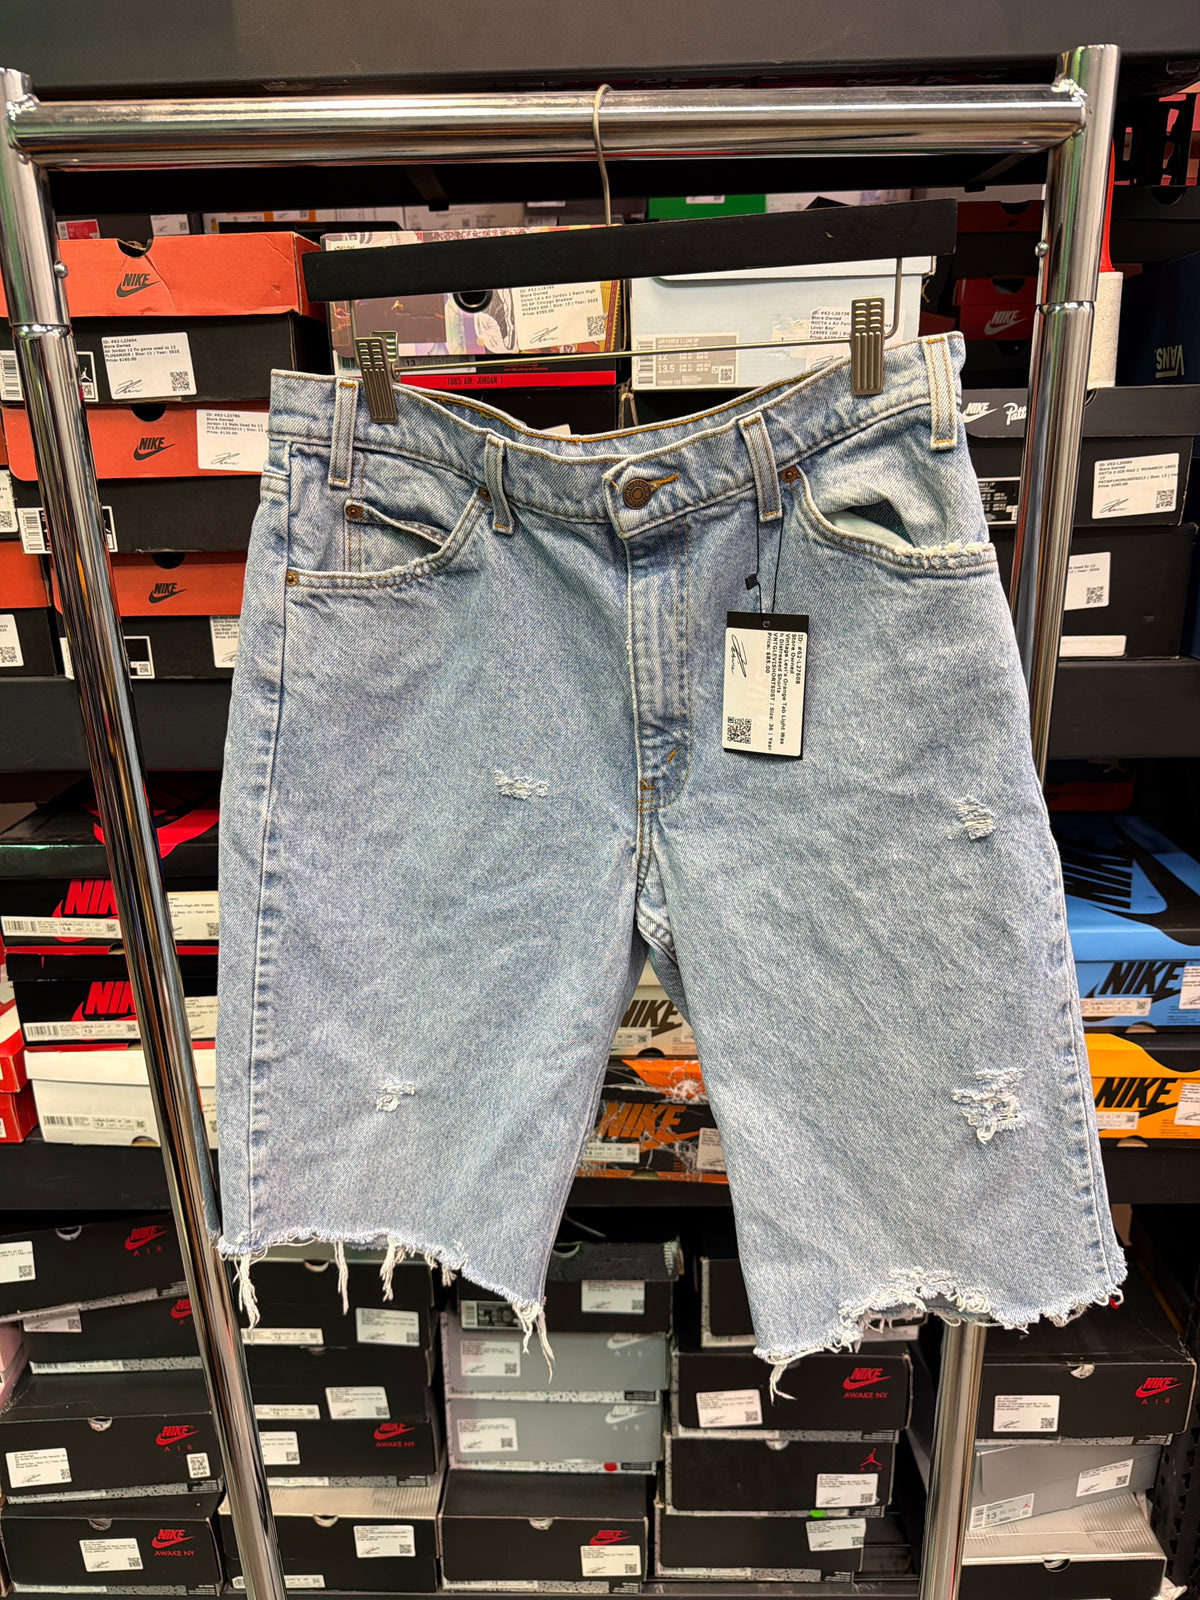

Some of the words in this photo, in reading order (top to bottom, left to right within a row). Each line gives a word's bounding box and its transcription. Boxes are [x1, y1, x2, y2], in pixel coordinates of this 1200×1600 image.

[122, 273, 150, 287] NIKE
[991, 310, 1020, 324] NIKE
[1155, 344, 1184, 378] VANS
[658, 364, 674, 373] 13.5
[476, 376, 497, 385] JORDAN
[966, 402, 990, 414] NIKE
[139, 437, 165, 450] NIKE
[154, 582, 177, 594] NIKE
[1098, 962, 1187, 994] NIKE
[1094, 1078, 1179, 1108] NIKE
[600, 1102, 686, 1138] NIKE
[130, 1226, 162, 1240] NIKE
[851, 1368, 883, 1380] NIKE
[1143, 1378, 1174, 1389] NIKE
[611, 1405, 640, 1415] NIKE
[162, 1425, 189, 1437] NIKE
[164, 1444, 192, 1452] AIR
[987, 1512, 997, 1520] 13
[157, 1529, 185, 1540] NIKE
